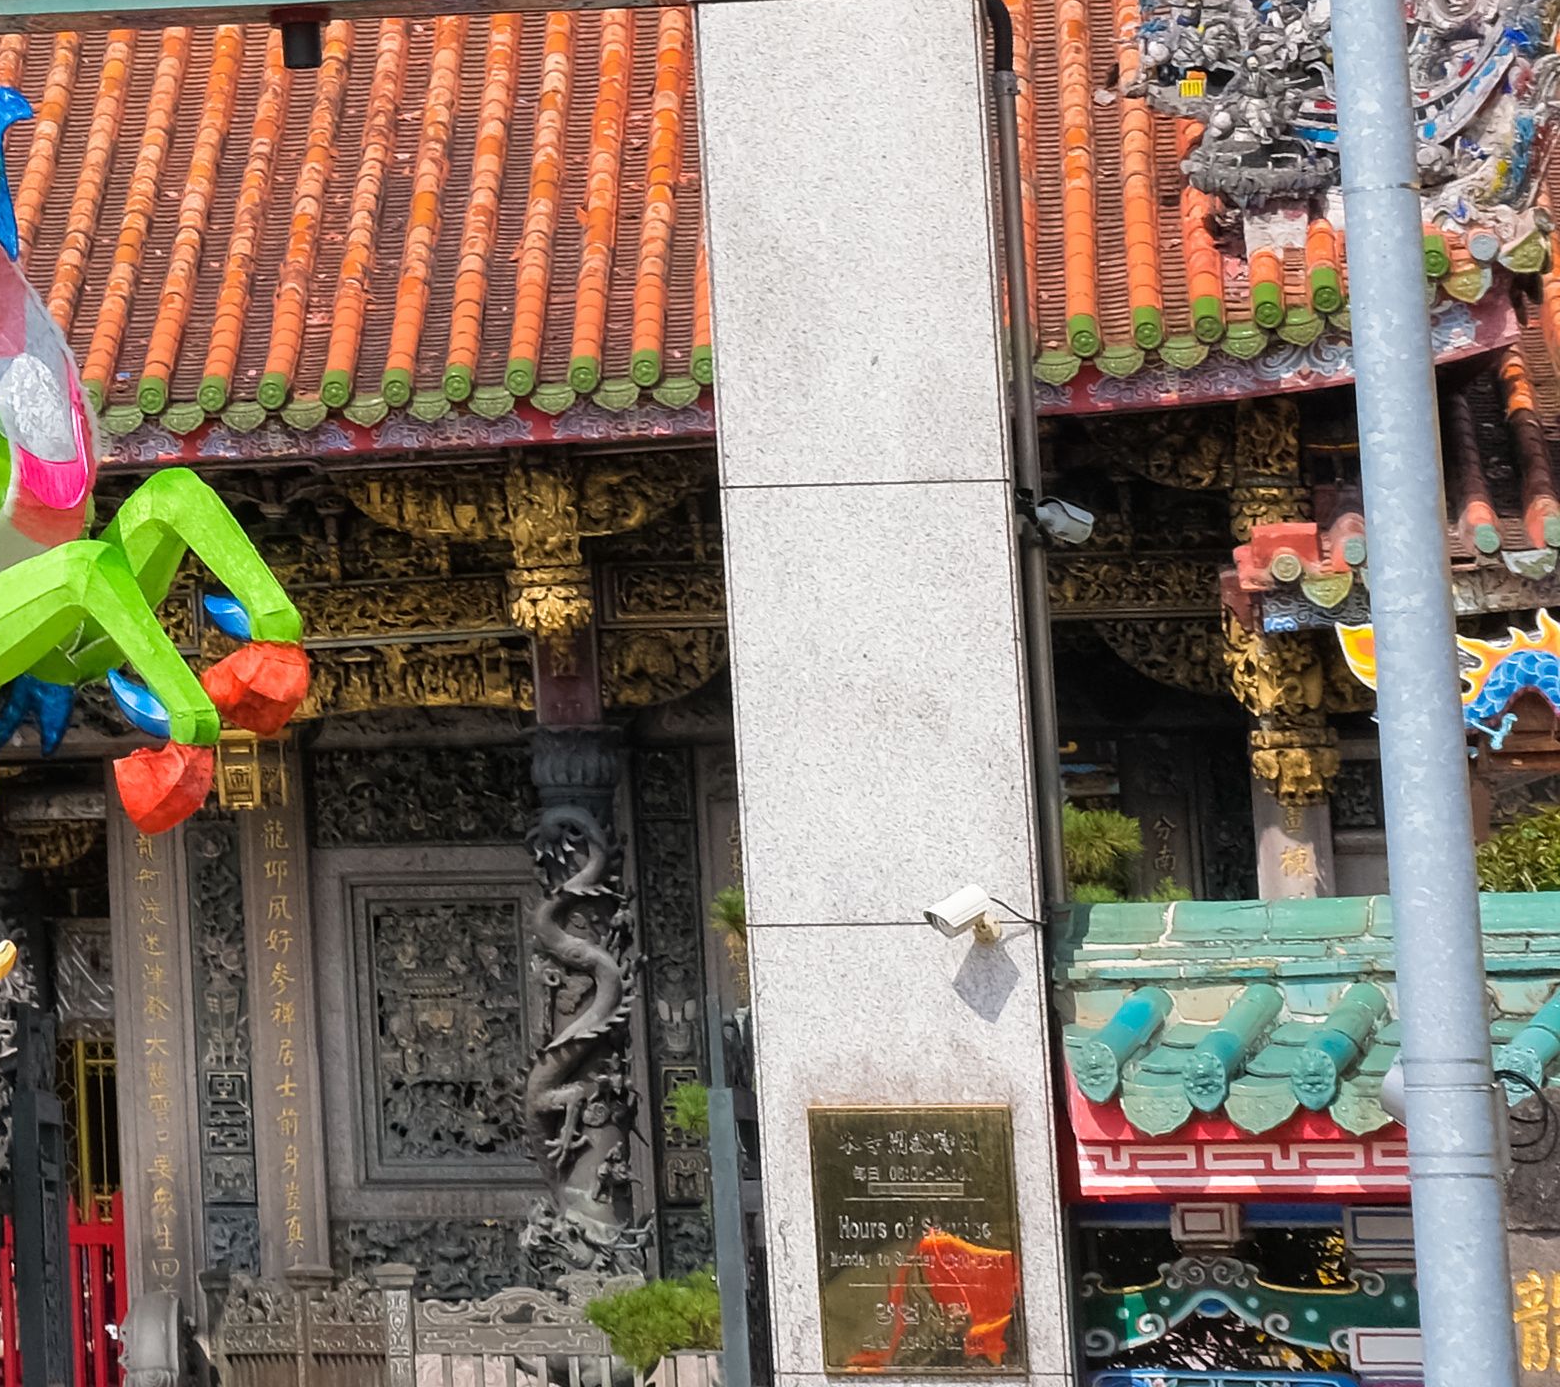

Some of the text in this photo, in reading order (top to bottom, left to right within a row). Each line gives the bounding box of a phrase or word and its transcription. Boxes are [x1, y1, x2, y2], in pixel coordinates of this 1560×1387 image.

[838, 1215, 887, 1240] Hours
[894, 1216, 914, 1240] of
[830, 1251, 871, 1269] Monday
[877, 1252, 891, 1268] to
